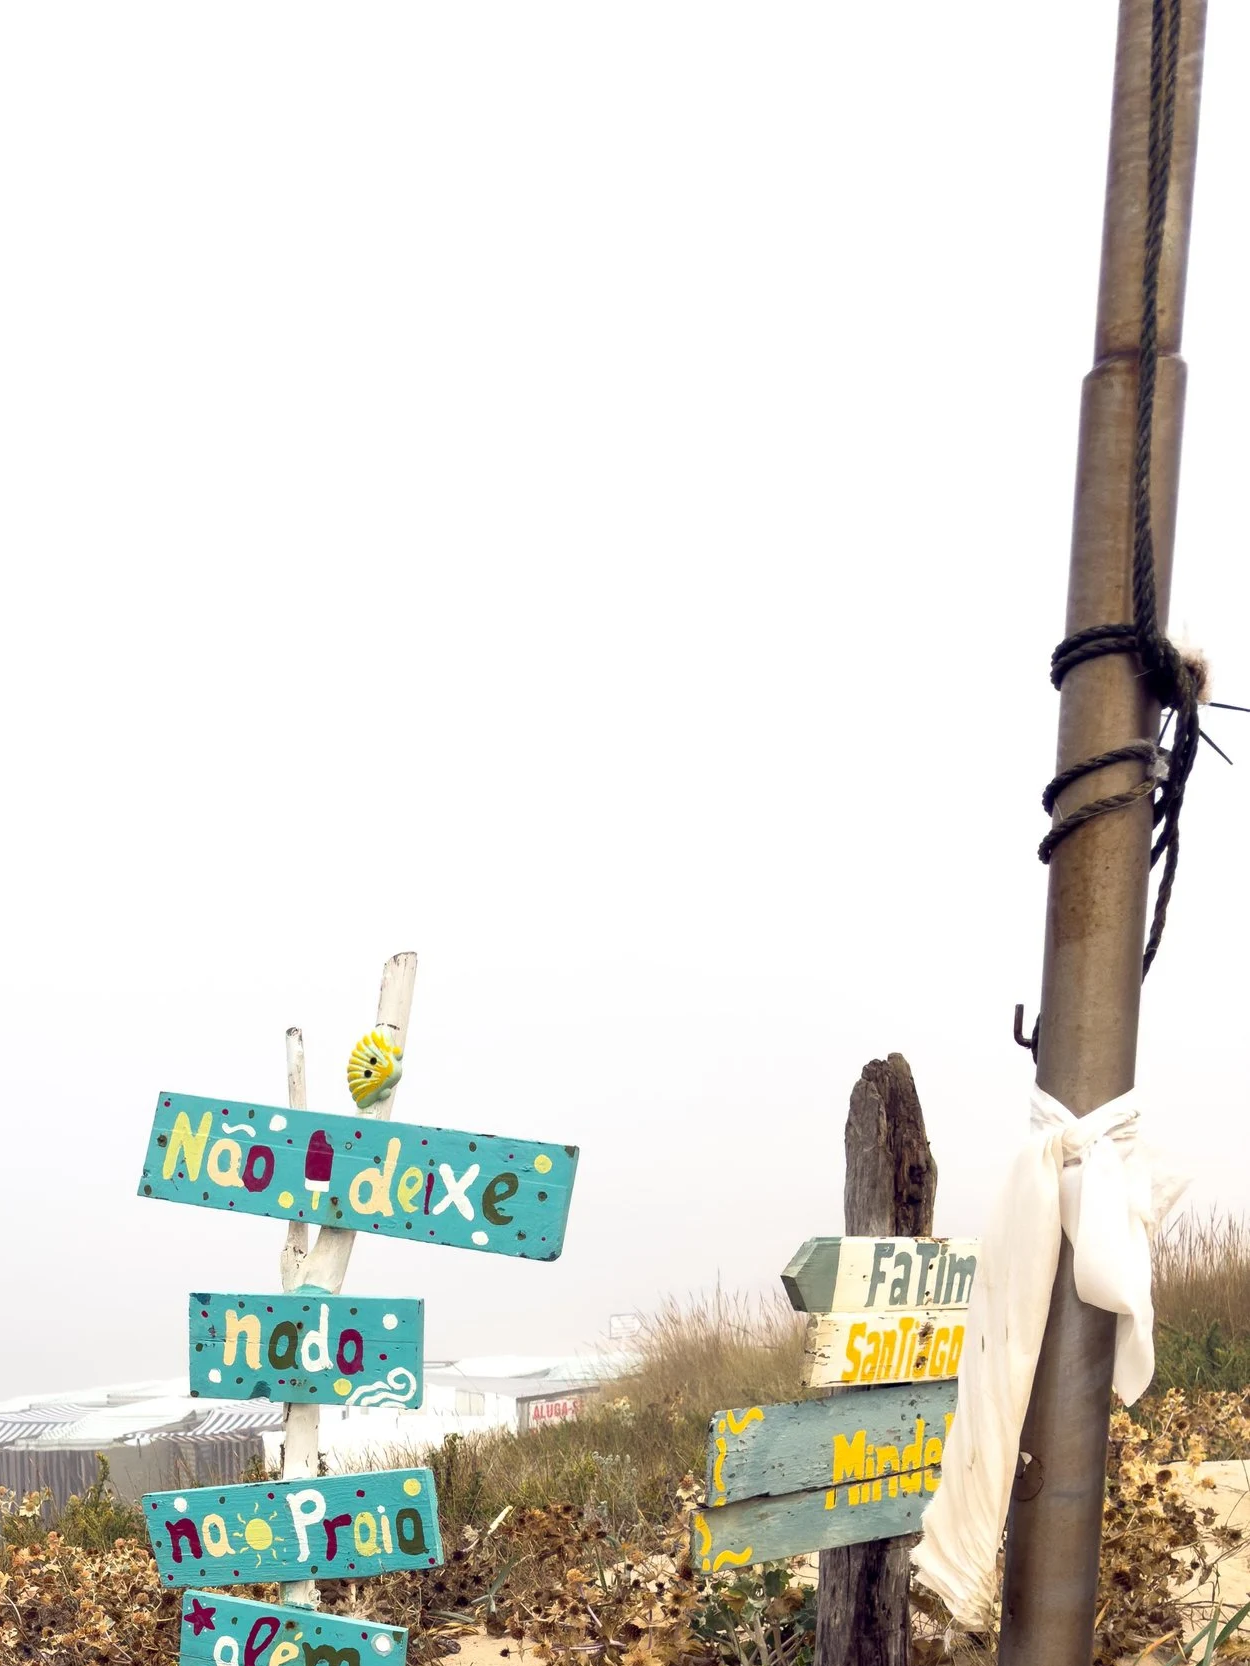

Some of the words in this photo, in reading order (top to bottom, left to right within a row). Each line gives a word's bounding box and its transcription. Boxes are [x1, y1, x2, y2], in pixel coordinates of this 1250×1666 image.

[162, 1111, 275, 1193] Não
[348, 1137, 520, 1226] deixe
[863, 1242, 978, 1308] FaTim
[223, 1303, 364, 1375] nada
[533, 1400, 583, 1420] ALUGA-S
[165, 1513, 232, 1564] na
[286, 1488, 429, 1563] Praia
